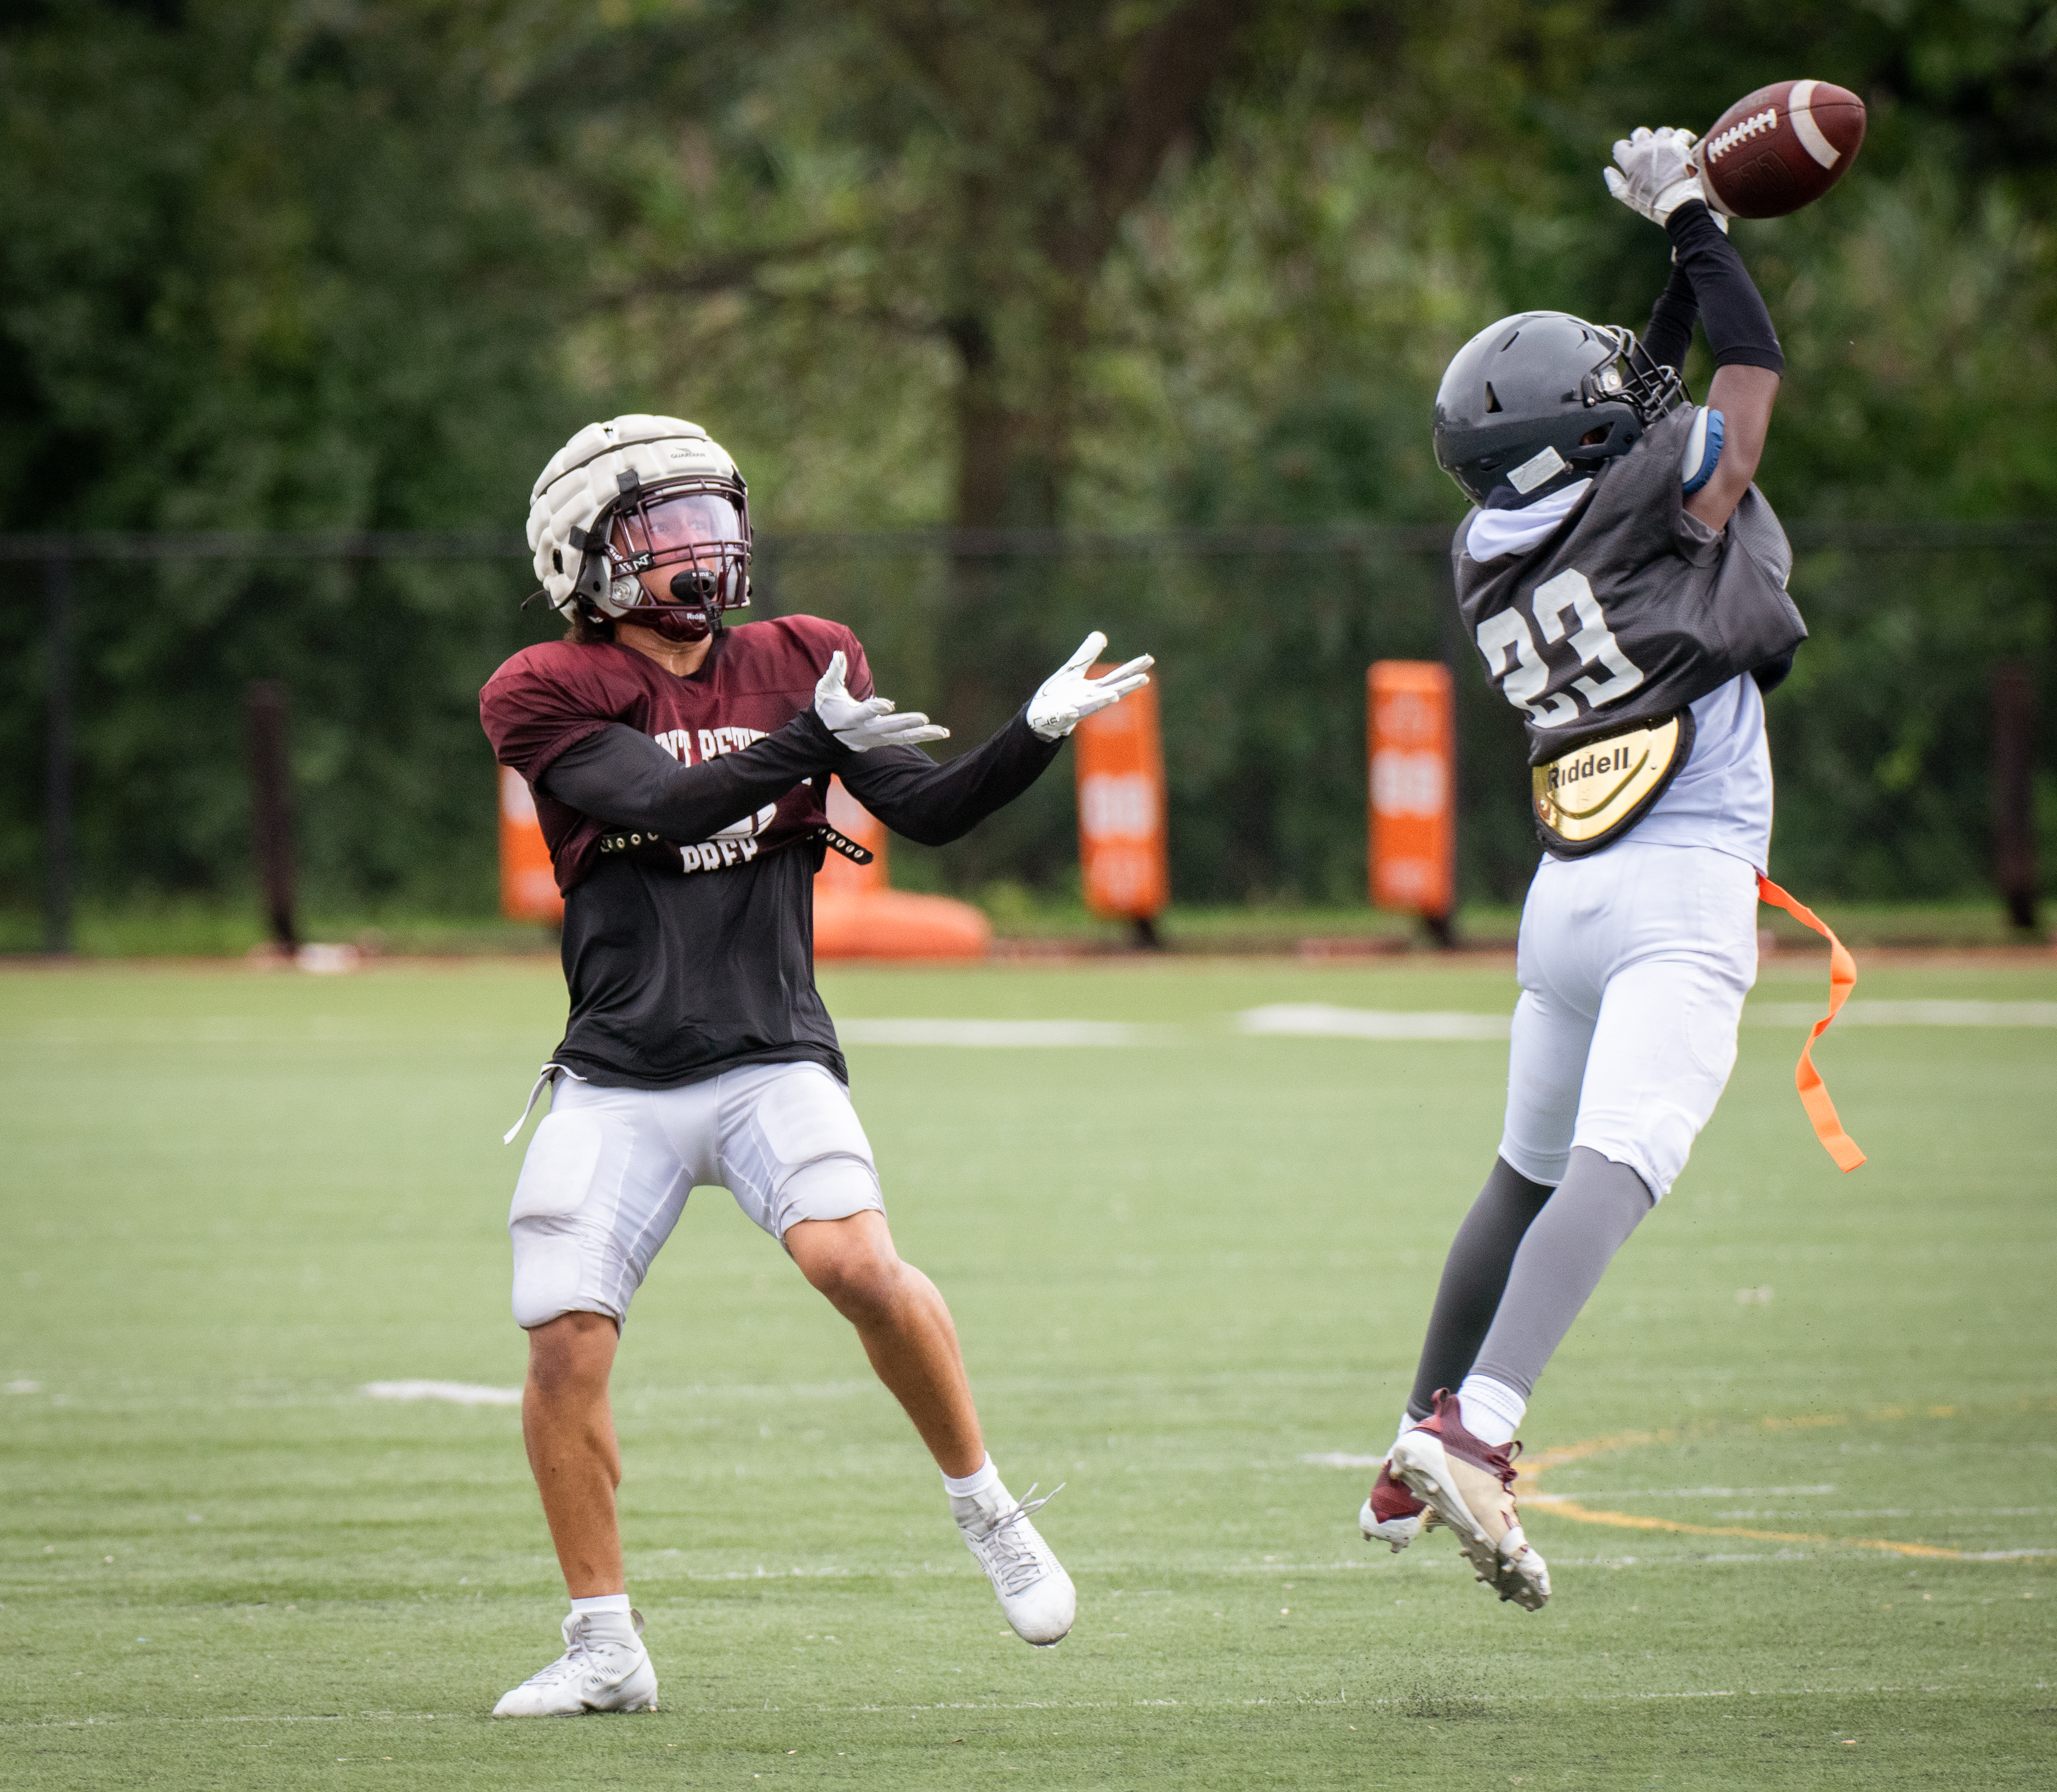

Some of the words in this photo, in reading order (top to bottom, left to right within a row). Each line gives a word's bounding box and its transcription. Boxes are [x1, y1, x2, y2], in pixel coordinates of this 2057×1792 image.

[1476, 567, 1644, 729] 23
[1548, 746, 1629, 792] Riddell
[679, 837, 758, 873] PREP
